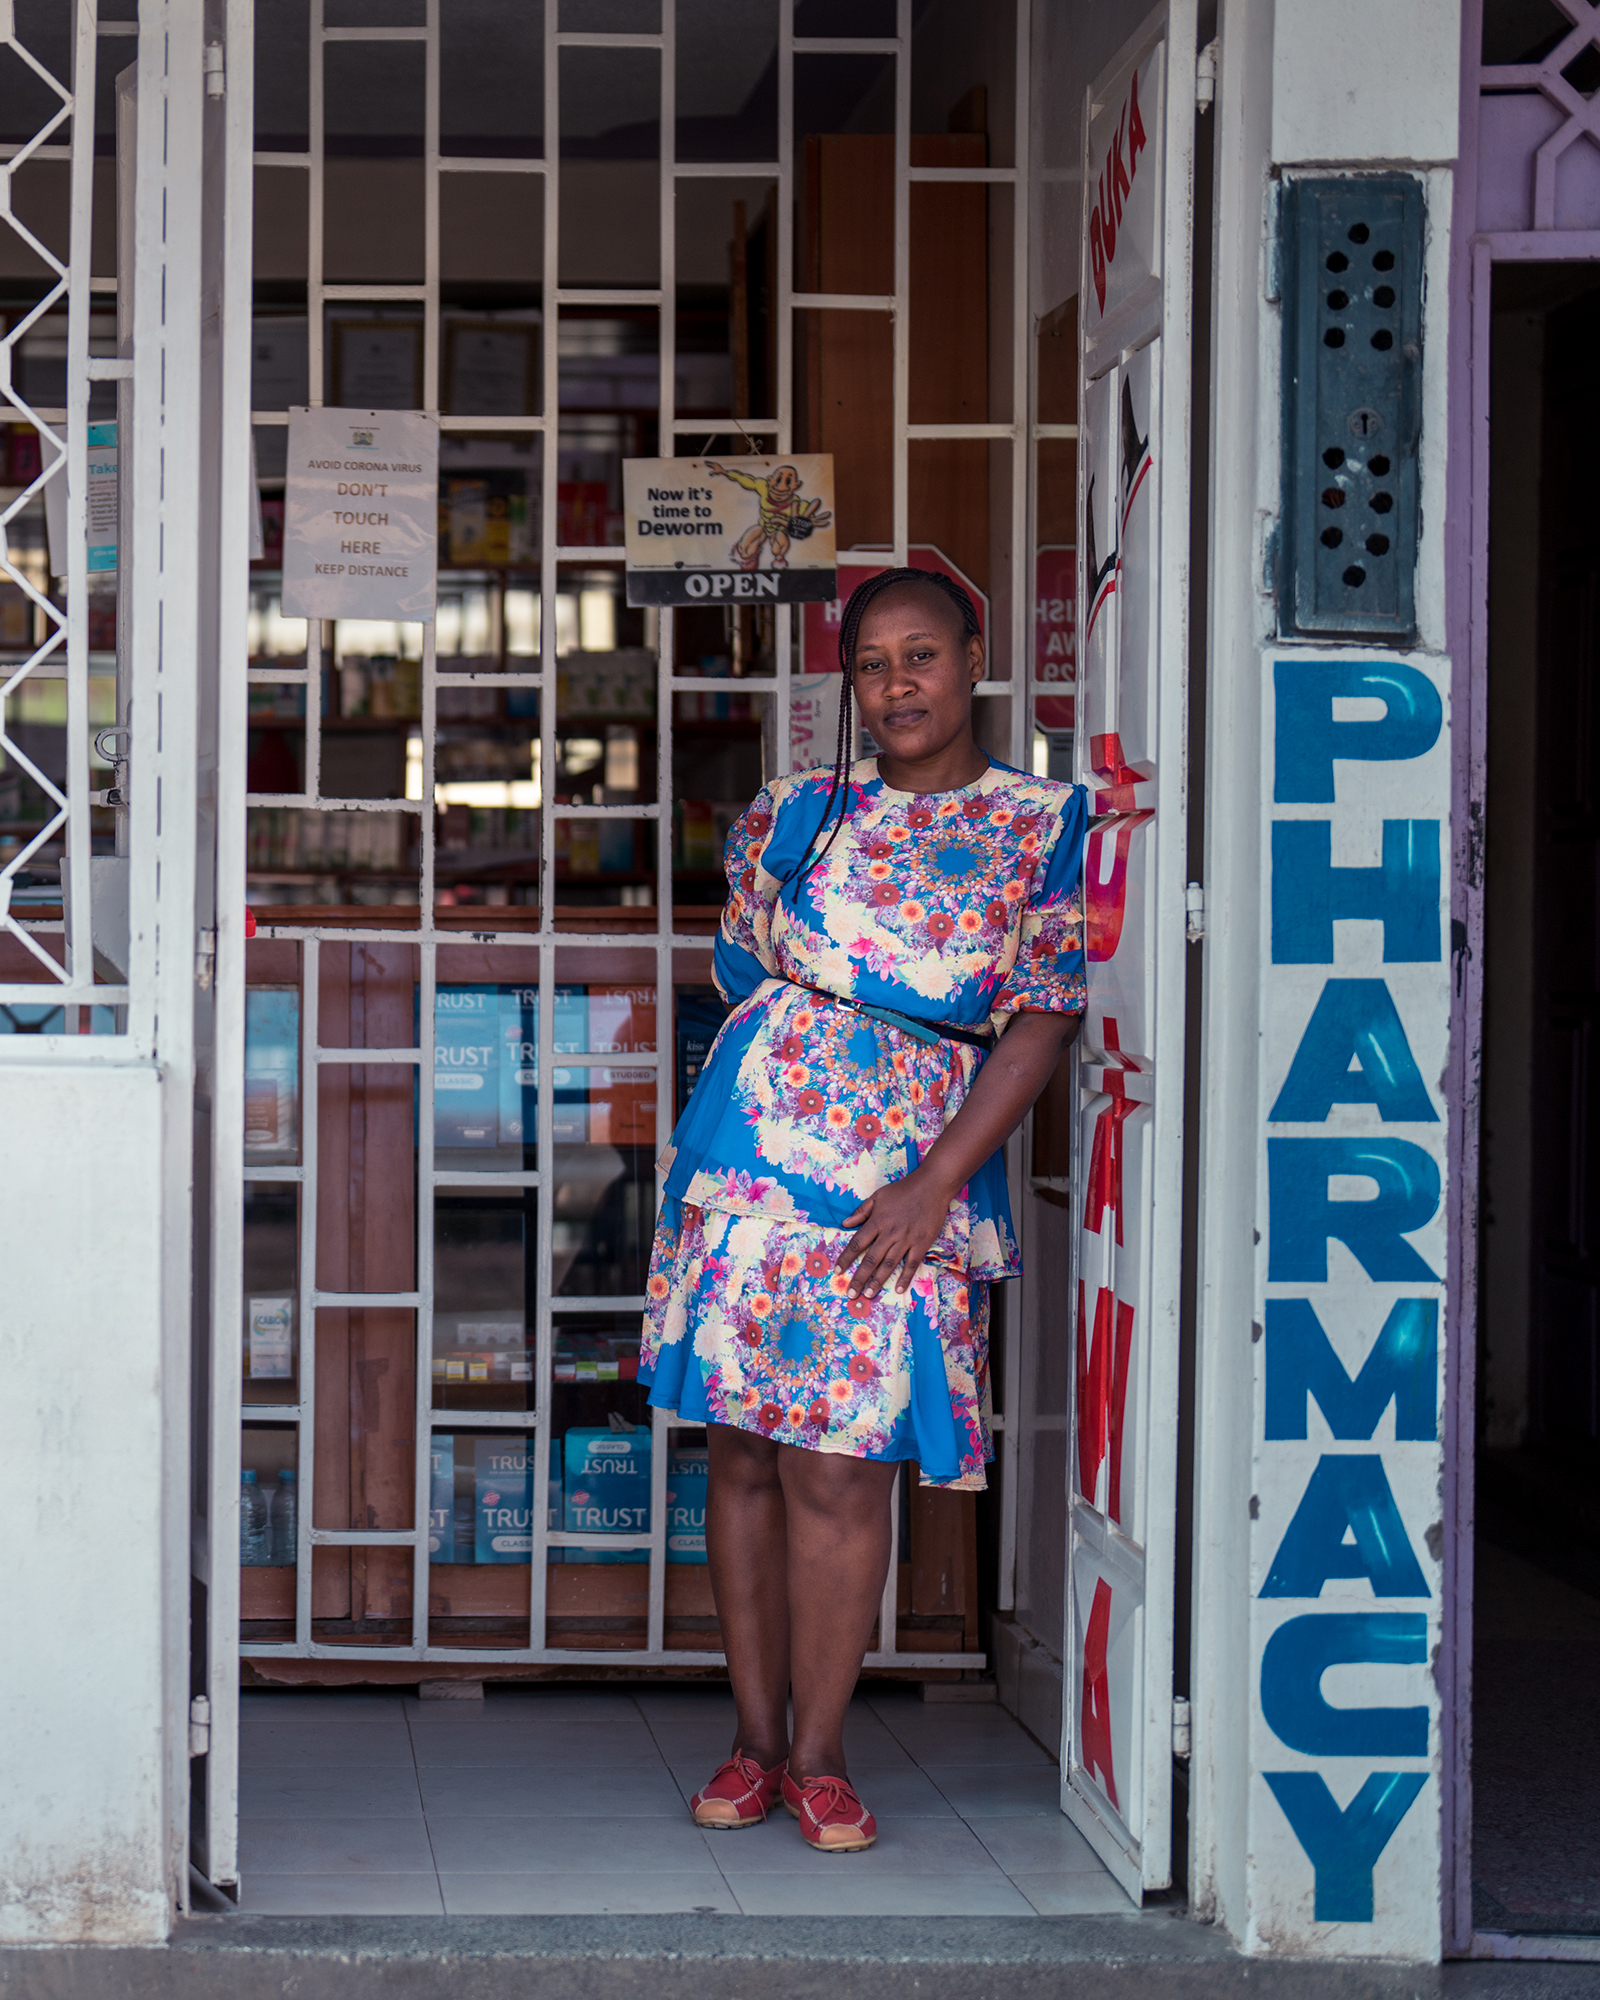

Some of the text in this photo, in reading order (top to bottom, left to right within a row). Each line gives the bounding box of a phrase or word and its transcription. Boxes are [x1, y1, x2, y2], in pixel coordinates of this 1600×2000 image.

[1090, 68, 1147, 319] DUKA
[89, 464, 118, 475] Take
[308, 460, 422, 473] AVOID CORONA VIRUS
[337, 483, 388, 497] DON’T
[647, 487, 713, 501] Now it's
[333, 511, 389, 526] TOUCH
[652, 505, 712, 518] time to
[638, 520, 723, 536] Deworm
[340, 540, 381, 555] HERE
[315, 563, 409, 578] KEEP DISTANCE
[685, 573, 781, 598] OPEN
[436, 993, 486, 1008] RUST
[687, 1041, 705, 1051] kiss
[435, 1046, 493, 1065] RUST
[1257, 660, 1442, 1923] PHARMACY
[488, 1455, 534, 1470] TRUS
[581, 1459, 638, 1474] TRUST
[571, 1508, 647, 1527] TRUST
